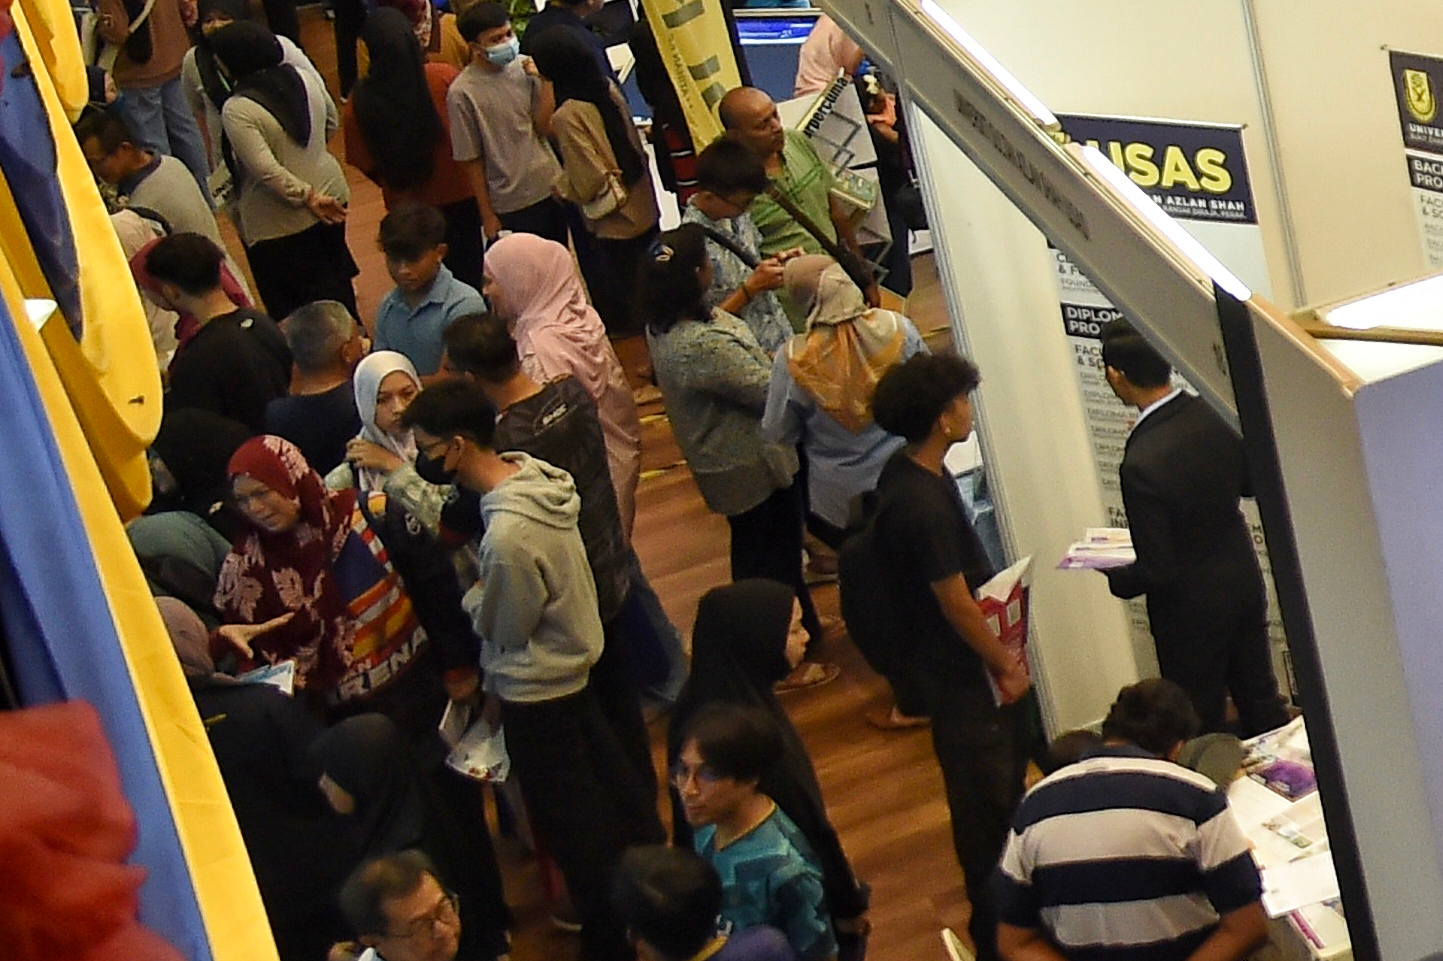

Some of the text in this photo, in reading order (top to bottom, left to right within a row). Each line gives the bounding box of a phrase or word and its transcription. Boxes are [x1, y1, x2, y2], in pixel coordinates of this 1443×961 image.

[1167, 195, 1244, 211] AZLAN SHAH
[1421, 207, 1429, 217] &
